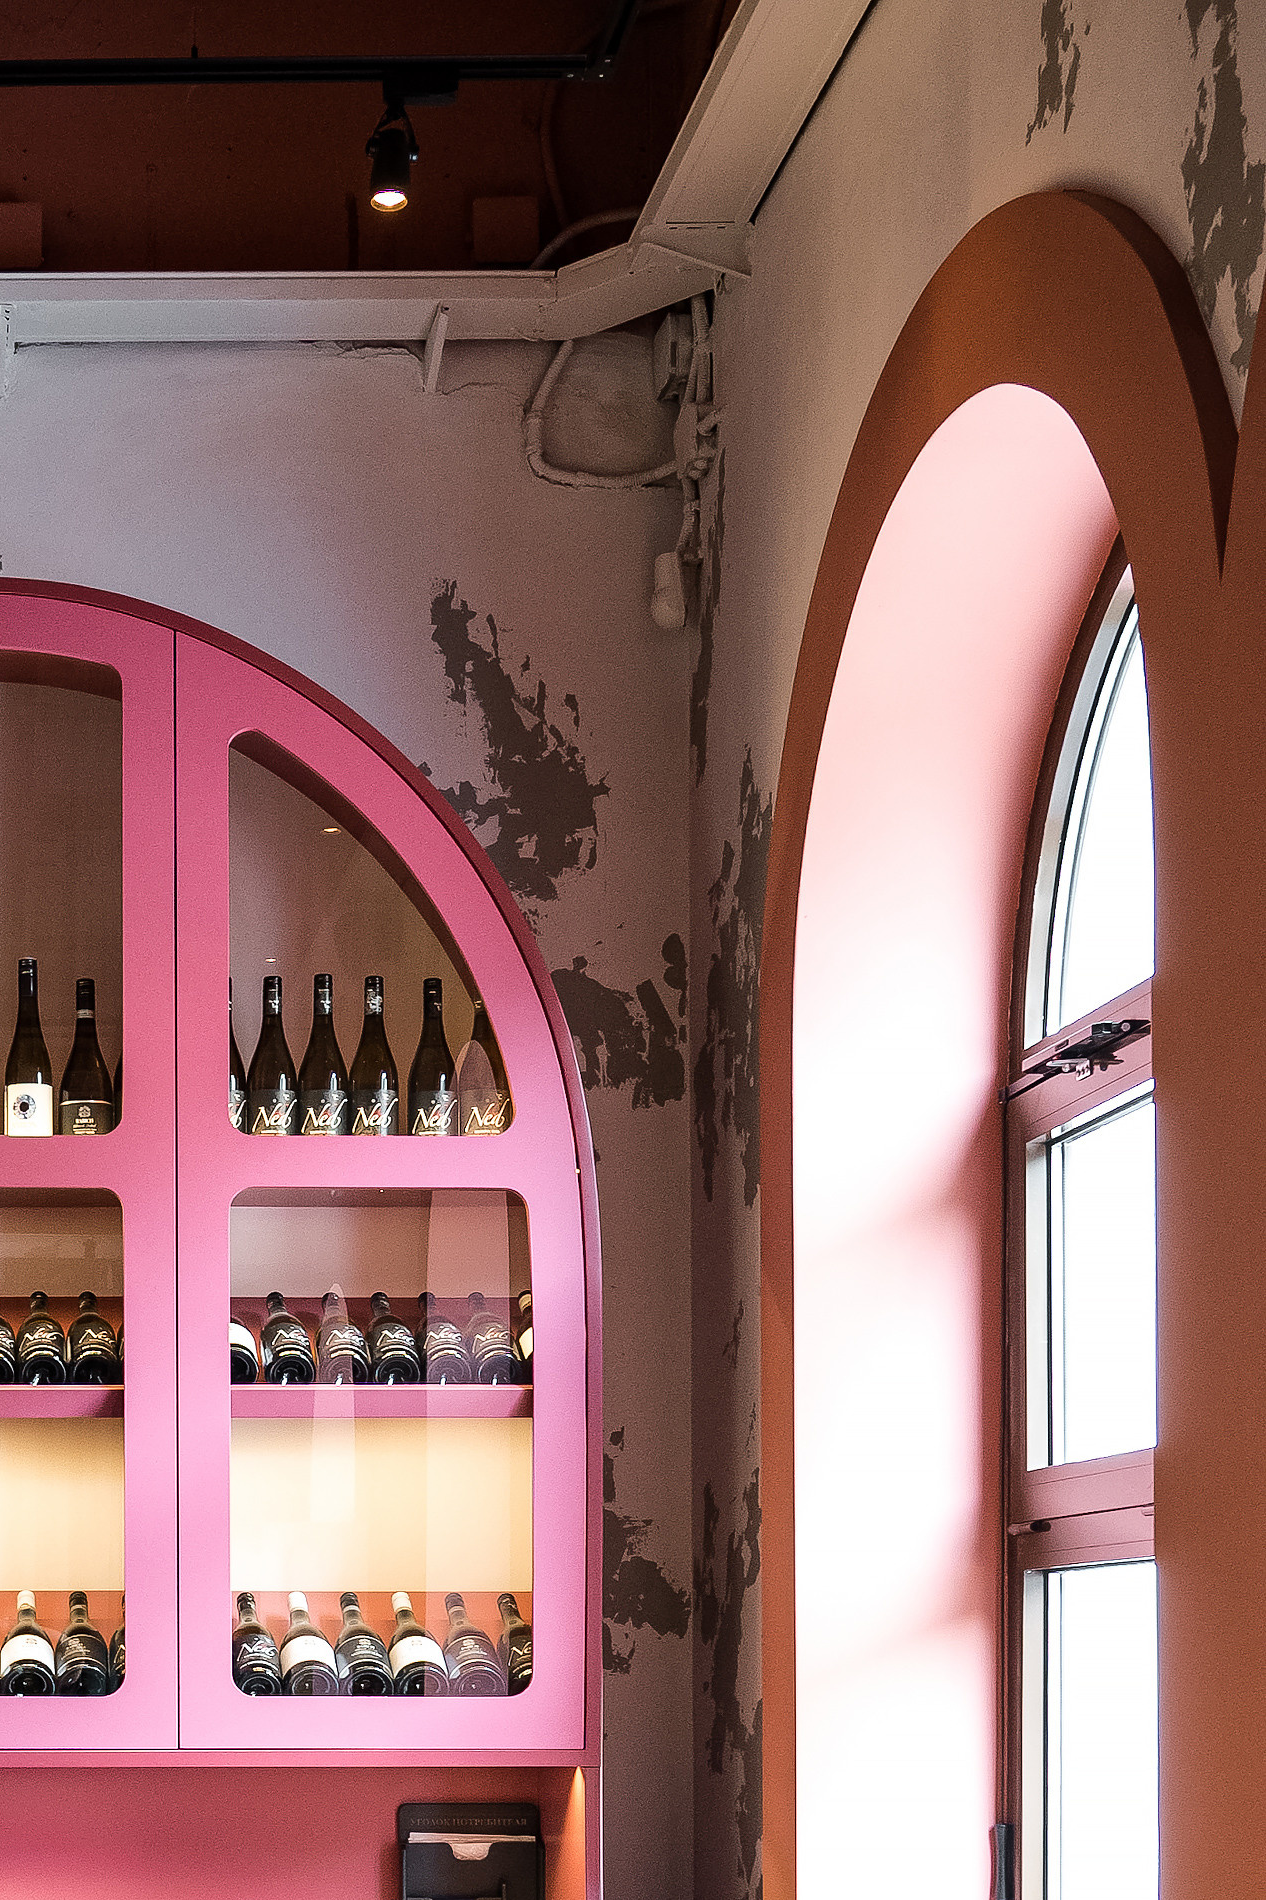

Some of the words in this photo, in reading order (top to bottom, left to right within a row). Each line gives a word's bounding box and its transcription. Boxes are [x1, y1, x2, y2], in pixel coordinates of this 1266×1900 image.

[252, 1099, 297, 1133] Ned
[301, 1099, 348, 1133] Ned
[352, 1098, 399, 1133] Ned
[412, 1099, 457, 1134] Ned
[465, 1098, 509, 1133] Ned
